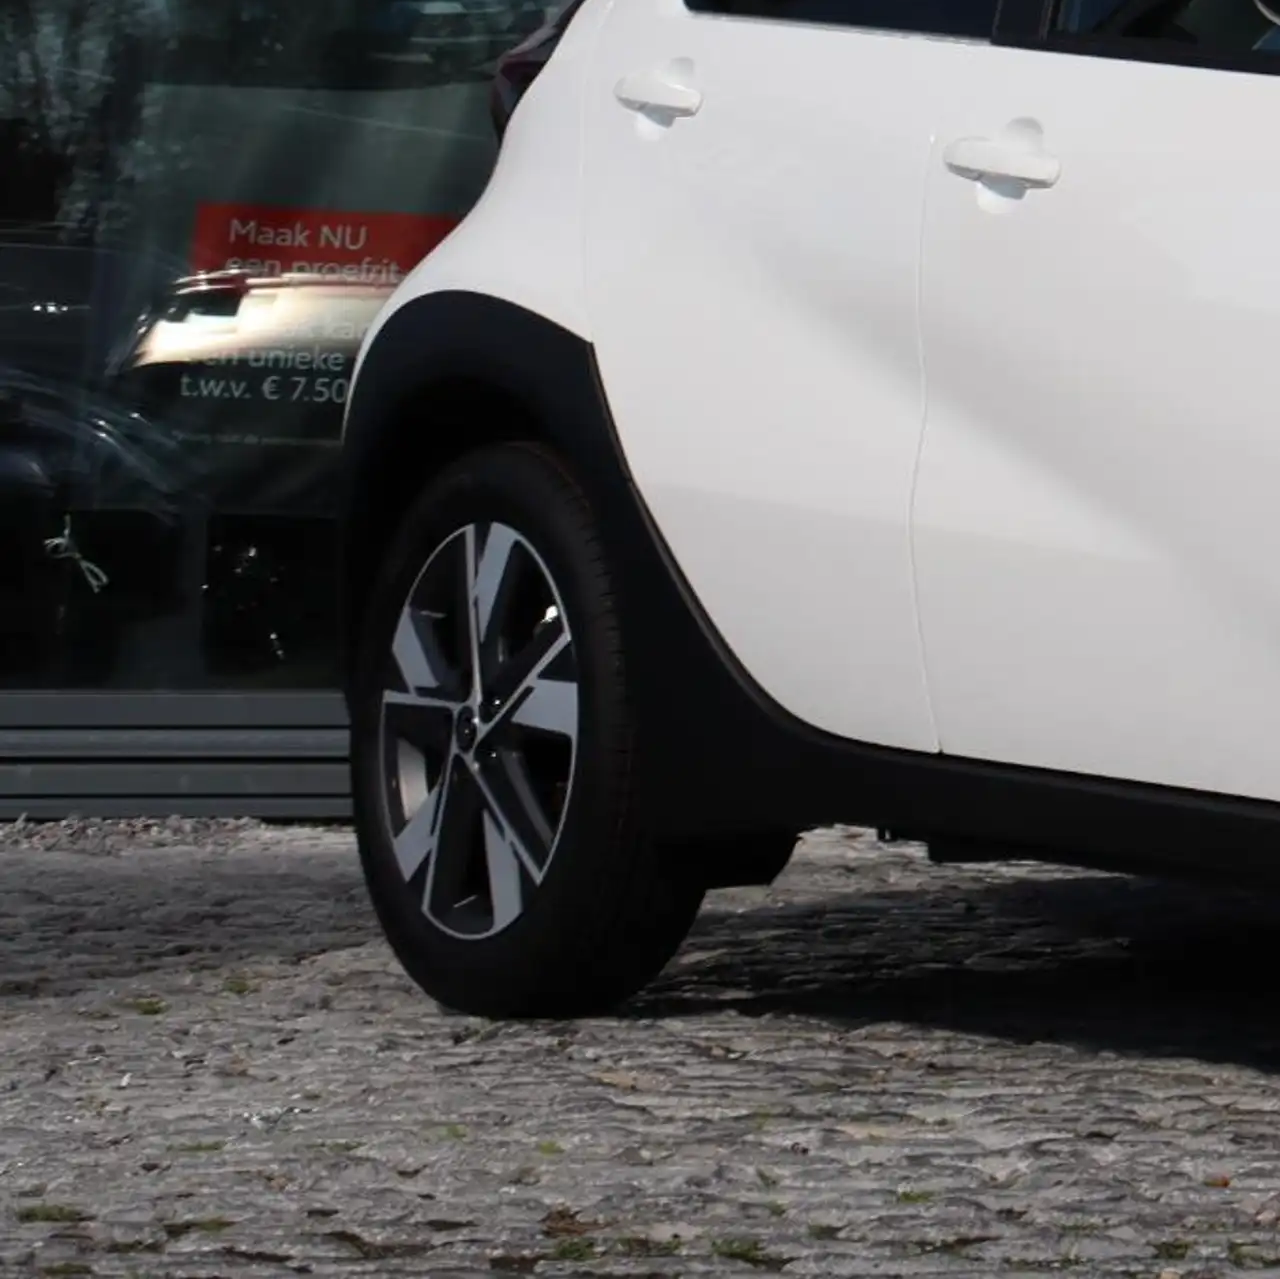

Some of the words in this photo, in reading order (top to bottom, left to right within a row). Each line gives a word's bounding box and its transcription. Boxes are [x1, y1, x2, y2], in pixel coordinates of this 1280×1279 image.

[228, 217, 312, 249] Maak
[318, 223, 368, 250] NU
[247, 344, 345, 372] unieke
[180, 373, 252, 399] t.w.v.
[262, 375, 282, 401] €
